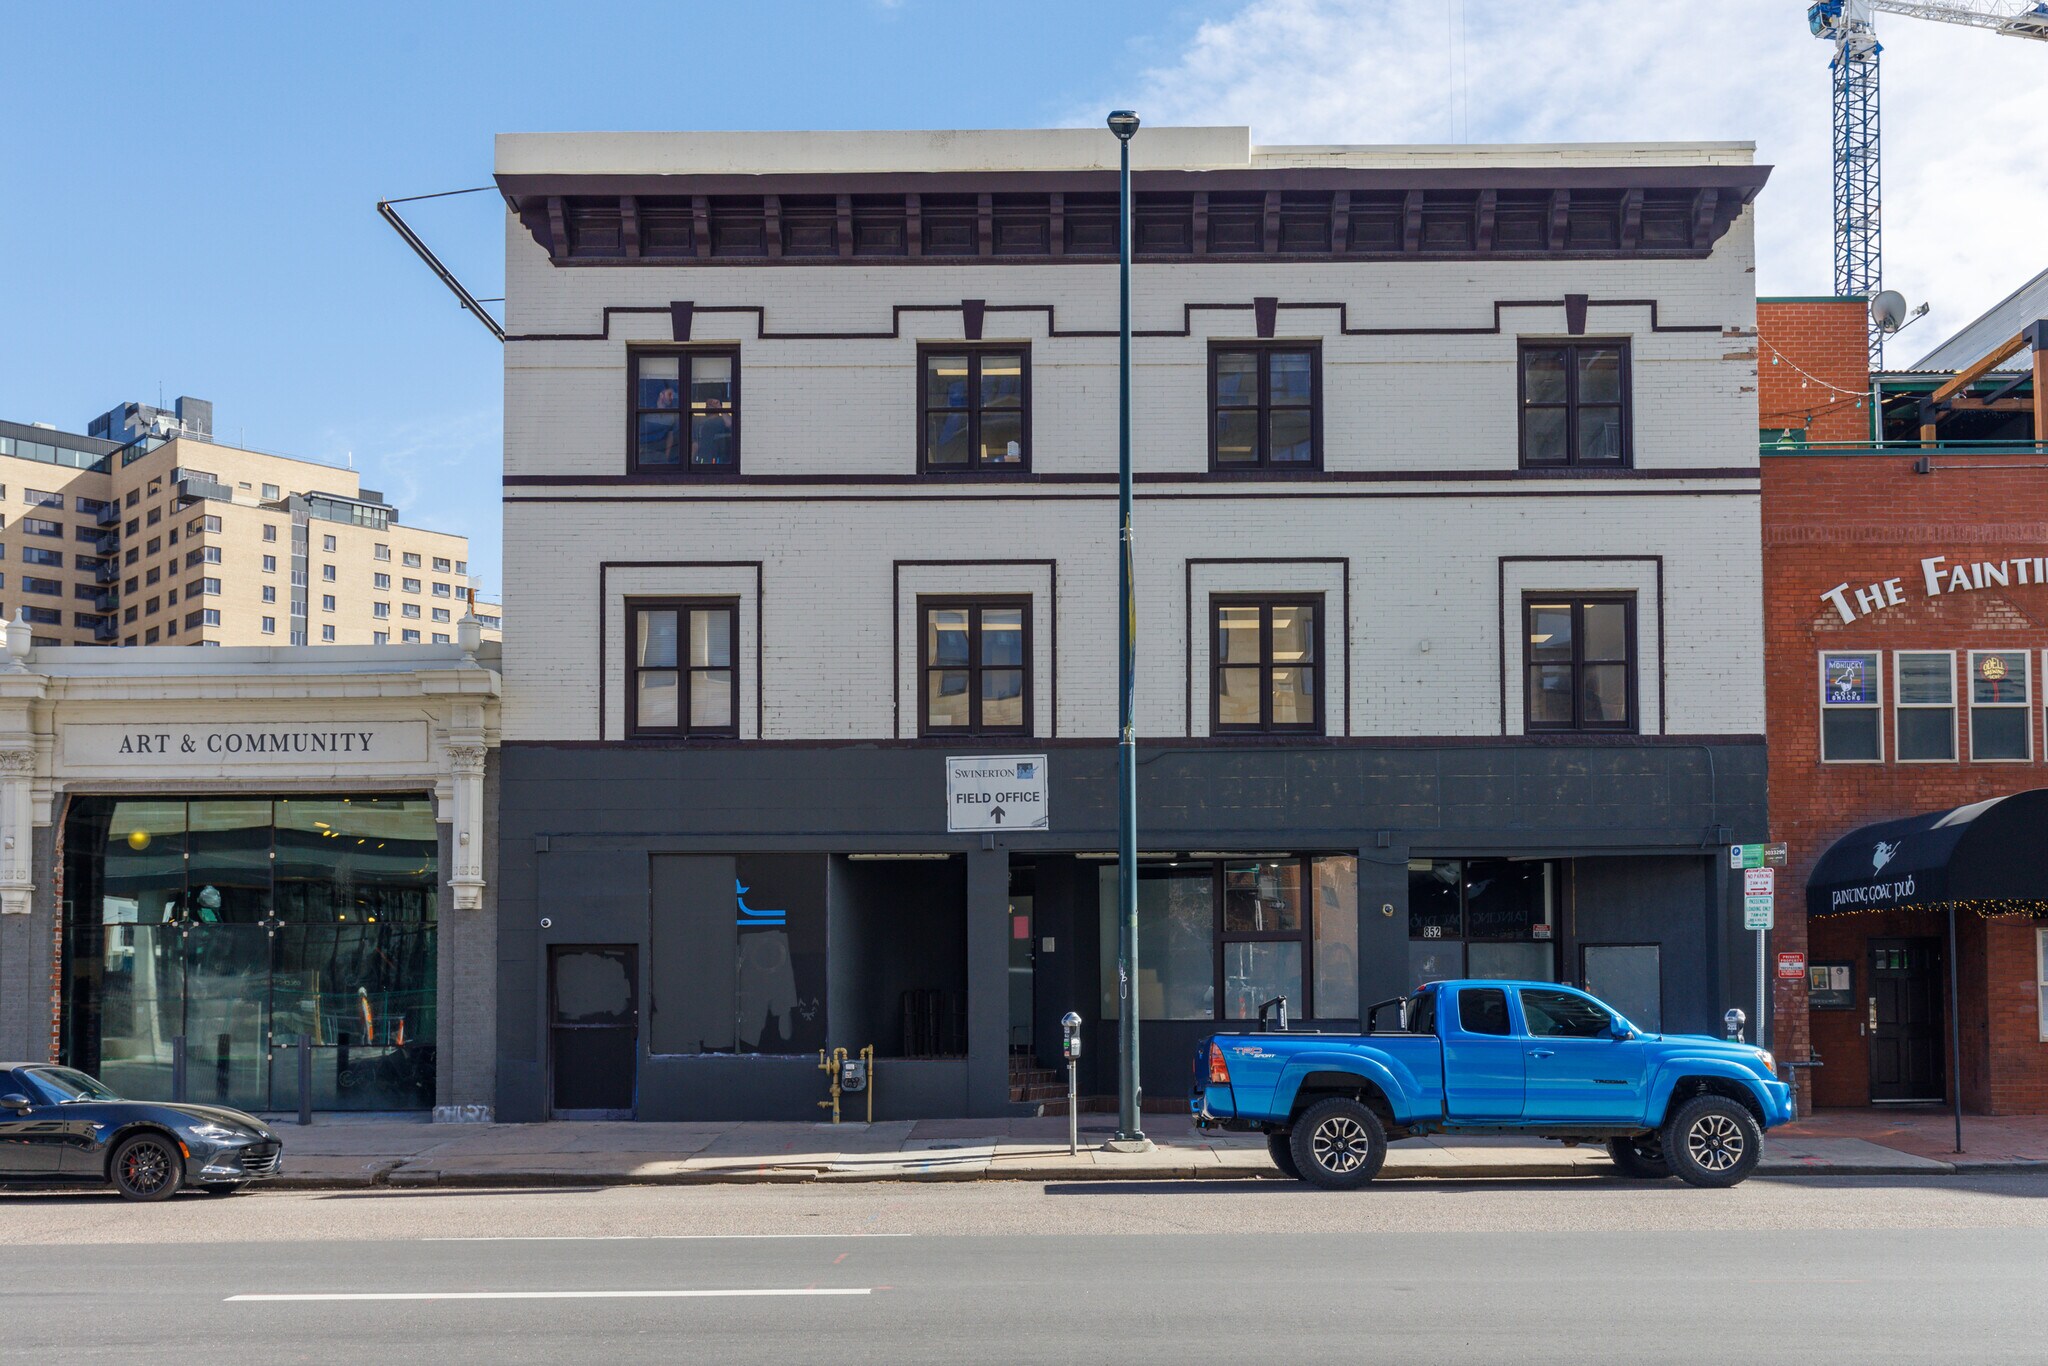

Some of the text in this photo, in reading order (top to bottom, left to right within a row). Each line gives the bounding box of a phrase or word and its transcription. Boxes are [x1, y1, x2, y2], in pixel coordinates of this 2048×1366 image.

[1819, 556, 2048, 625] THE FAINTI
[1983, 657, 2005, 671] ODELL
[119, 732, 374, 753] ART & COMMUNITY
[955, 768, 1015, 779] SWINERTON
[956, 791, 1040, 804] FIELD OFFICE
[1424, 926, 1441, 938] 852
[1232, 1046, 1263, 1056] TRD
